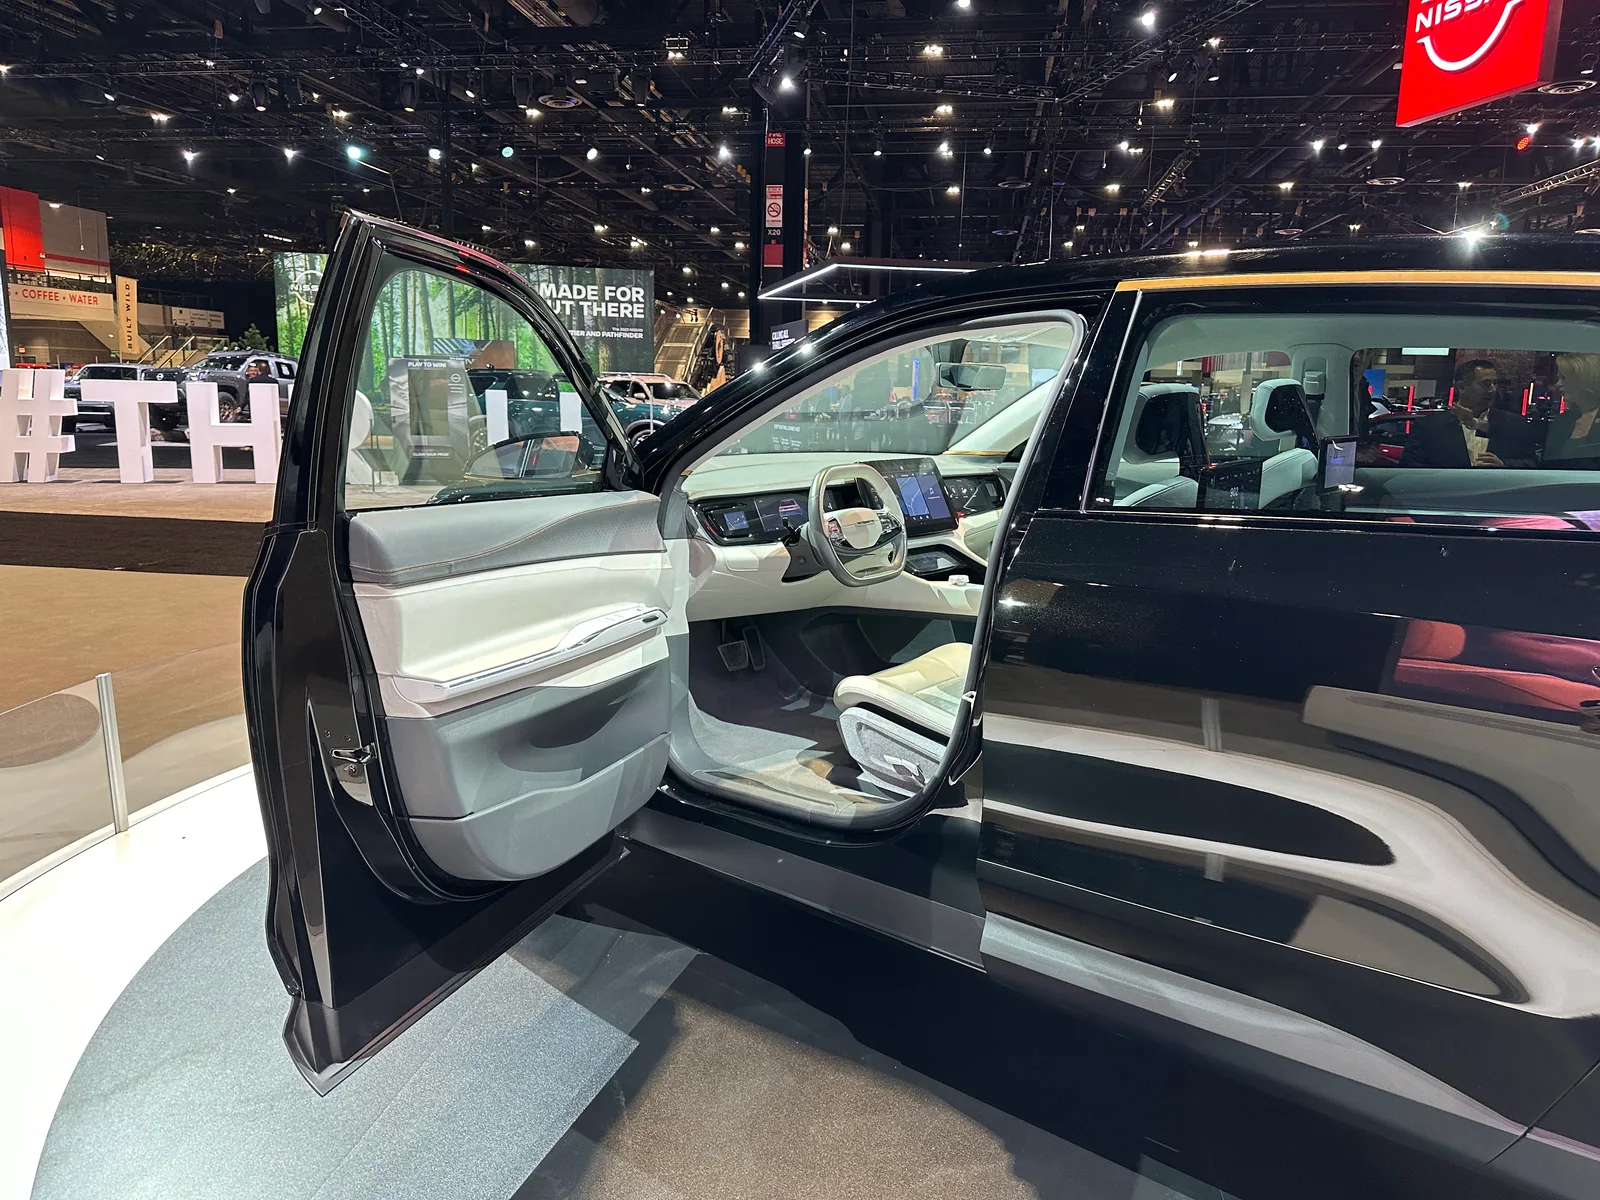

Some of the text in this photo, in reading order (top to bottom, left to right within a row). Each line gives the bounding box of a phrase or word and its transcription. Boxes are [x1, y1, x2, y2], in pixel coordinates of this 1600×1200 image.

[1415, 0, 1490, 33] NISS
[22, 288, 60, 301] COFFEE
[69, 293, 99, 305] WATER
[290, 284, 319, 292] NISS
[540, 282, 645, 302] MADE FOR
[547, 299, 645, 318] UT THERE
[125, 316, 133, 349] BUILT
[602, 331, 644, 339] PATHFINDER
